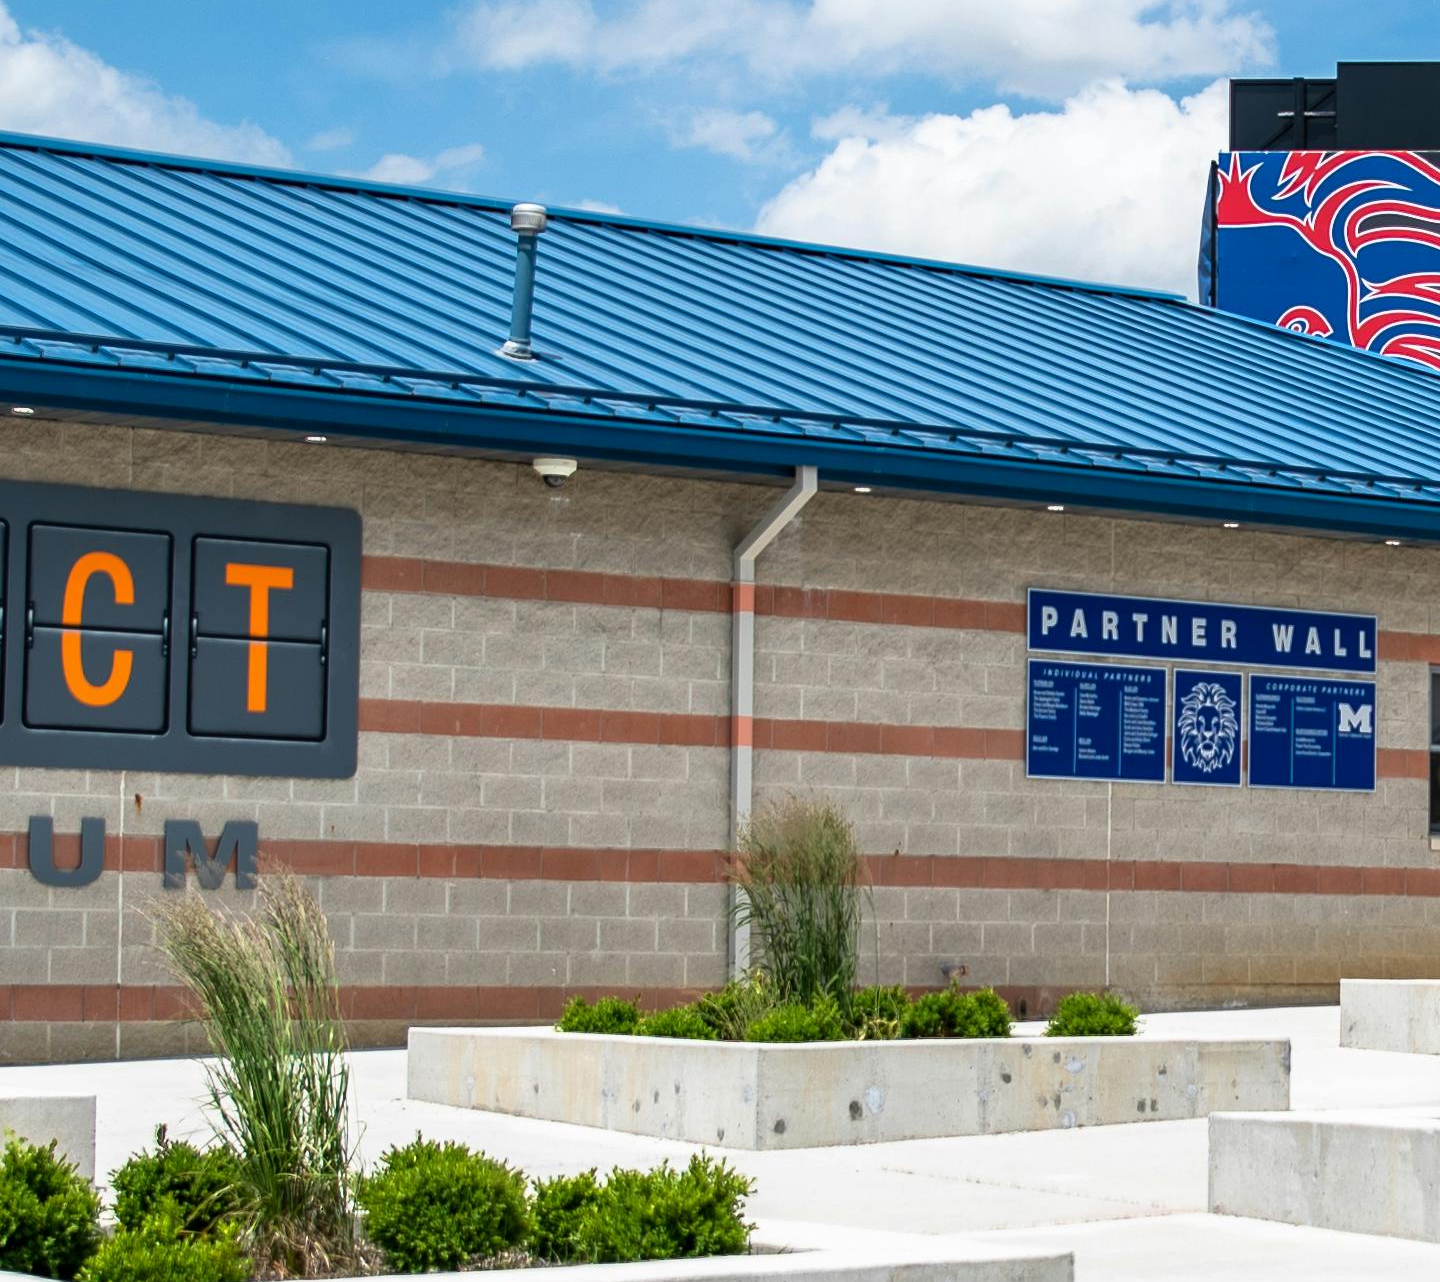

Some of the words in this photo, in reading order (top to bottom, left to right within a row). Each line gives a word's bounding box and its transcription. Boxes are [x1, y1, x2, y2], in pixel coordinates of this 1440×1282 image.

[1041, 606, 1238, 648] PARTNER
[1271, 622, 1372, 659] WALL
[1042, 667, 1099, 680] INDIVIDUAL
[1103, 671, 1152, 684] PARTNERS
[1265, 682, 1318, 694] CORPORATE
[1321, 685, 1366, 697] PARTNERS
[1338, 702, 1373, 733] M
